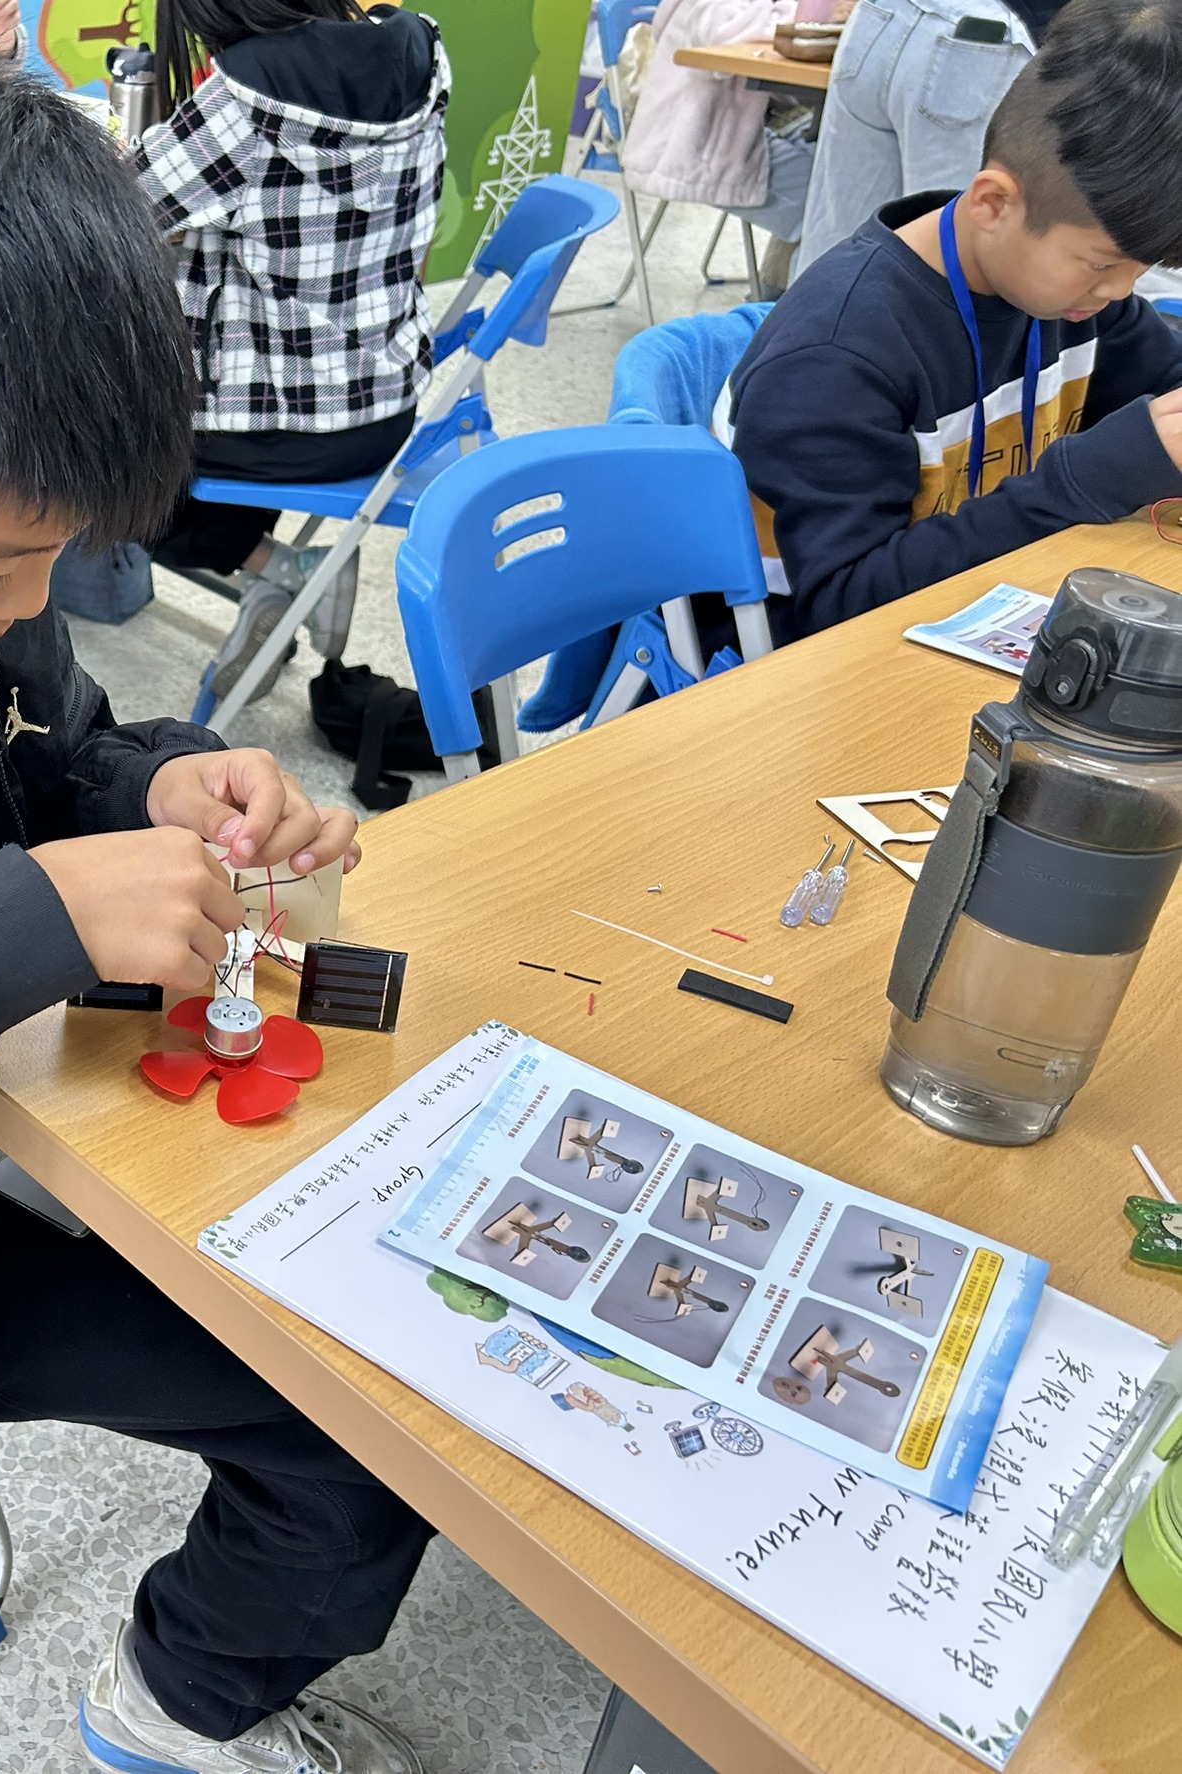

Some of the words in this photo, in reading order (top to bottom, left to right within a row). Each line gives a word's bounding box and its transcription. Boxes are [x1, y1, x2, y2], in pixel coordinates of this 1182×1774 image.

[387, 1229, 402, 1238] 2
[834, 1460, 878, 1498] ur
[725, 1493, 843, 1581] Future!
[856, 1504, 905, 1551] Camp
